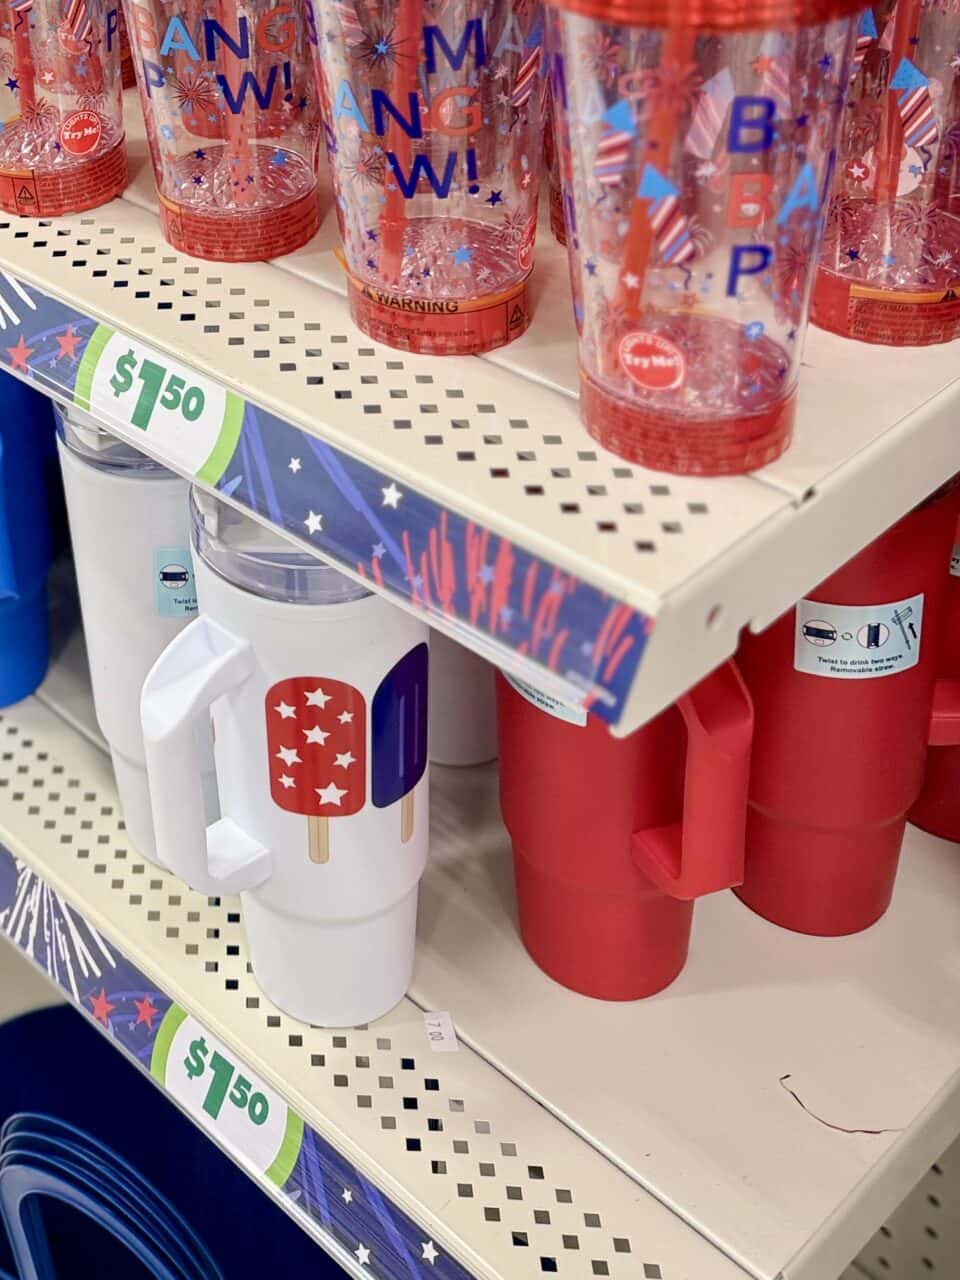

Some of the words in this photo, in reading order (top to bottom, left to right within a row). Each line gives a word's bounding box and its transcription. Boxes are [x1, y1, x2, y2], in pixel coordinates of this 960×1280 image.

[377, 293, 459, 314] WARNING
[817, 655, 839, 665] Twist
[839, 657, 849, 666] to
[849, 658, 870, 666] drink
